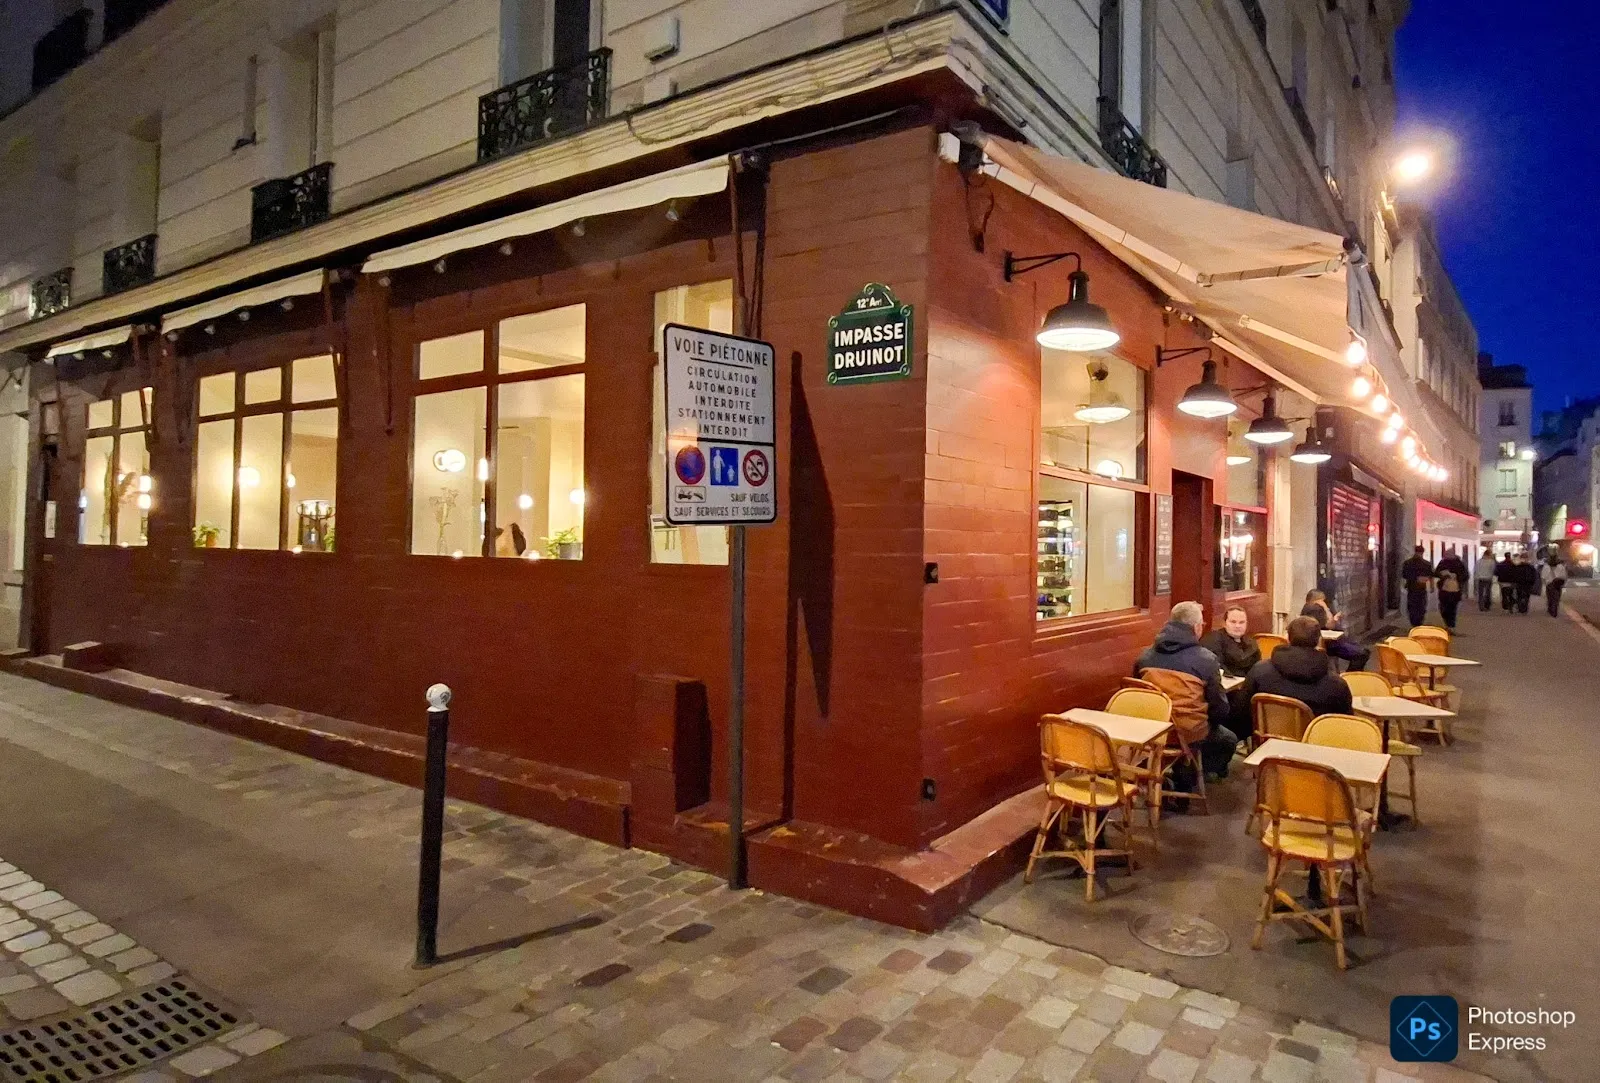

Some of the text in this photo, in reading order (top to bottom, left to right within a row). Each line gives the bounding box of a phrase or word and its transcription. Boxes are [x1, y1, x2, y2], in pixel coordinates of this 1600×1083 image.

[834, 322, 904, 347] IMPASSE
[674, 337, 768, 366] VOIE PIÉTONNE
[834, 345, 904, 369] DRUINOT
[687, 366, 757, 384] CIRCULATION
[688, 380, 756, 398] AUTOMOBILE
[695, 395, 751, 411] INTERDITE
[678, 408, 766, 425] STATIONNEMENT
[698, 423, 748, 437] INTERDIT
[730, 493, 746, 503] SAUF
[674, 506, 771, 516] SAUF SERVICES ET SECOURS
